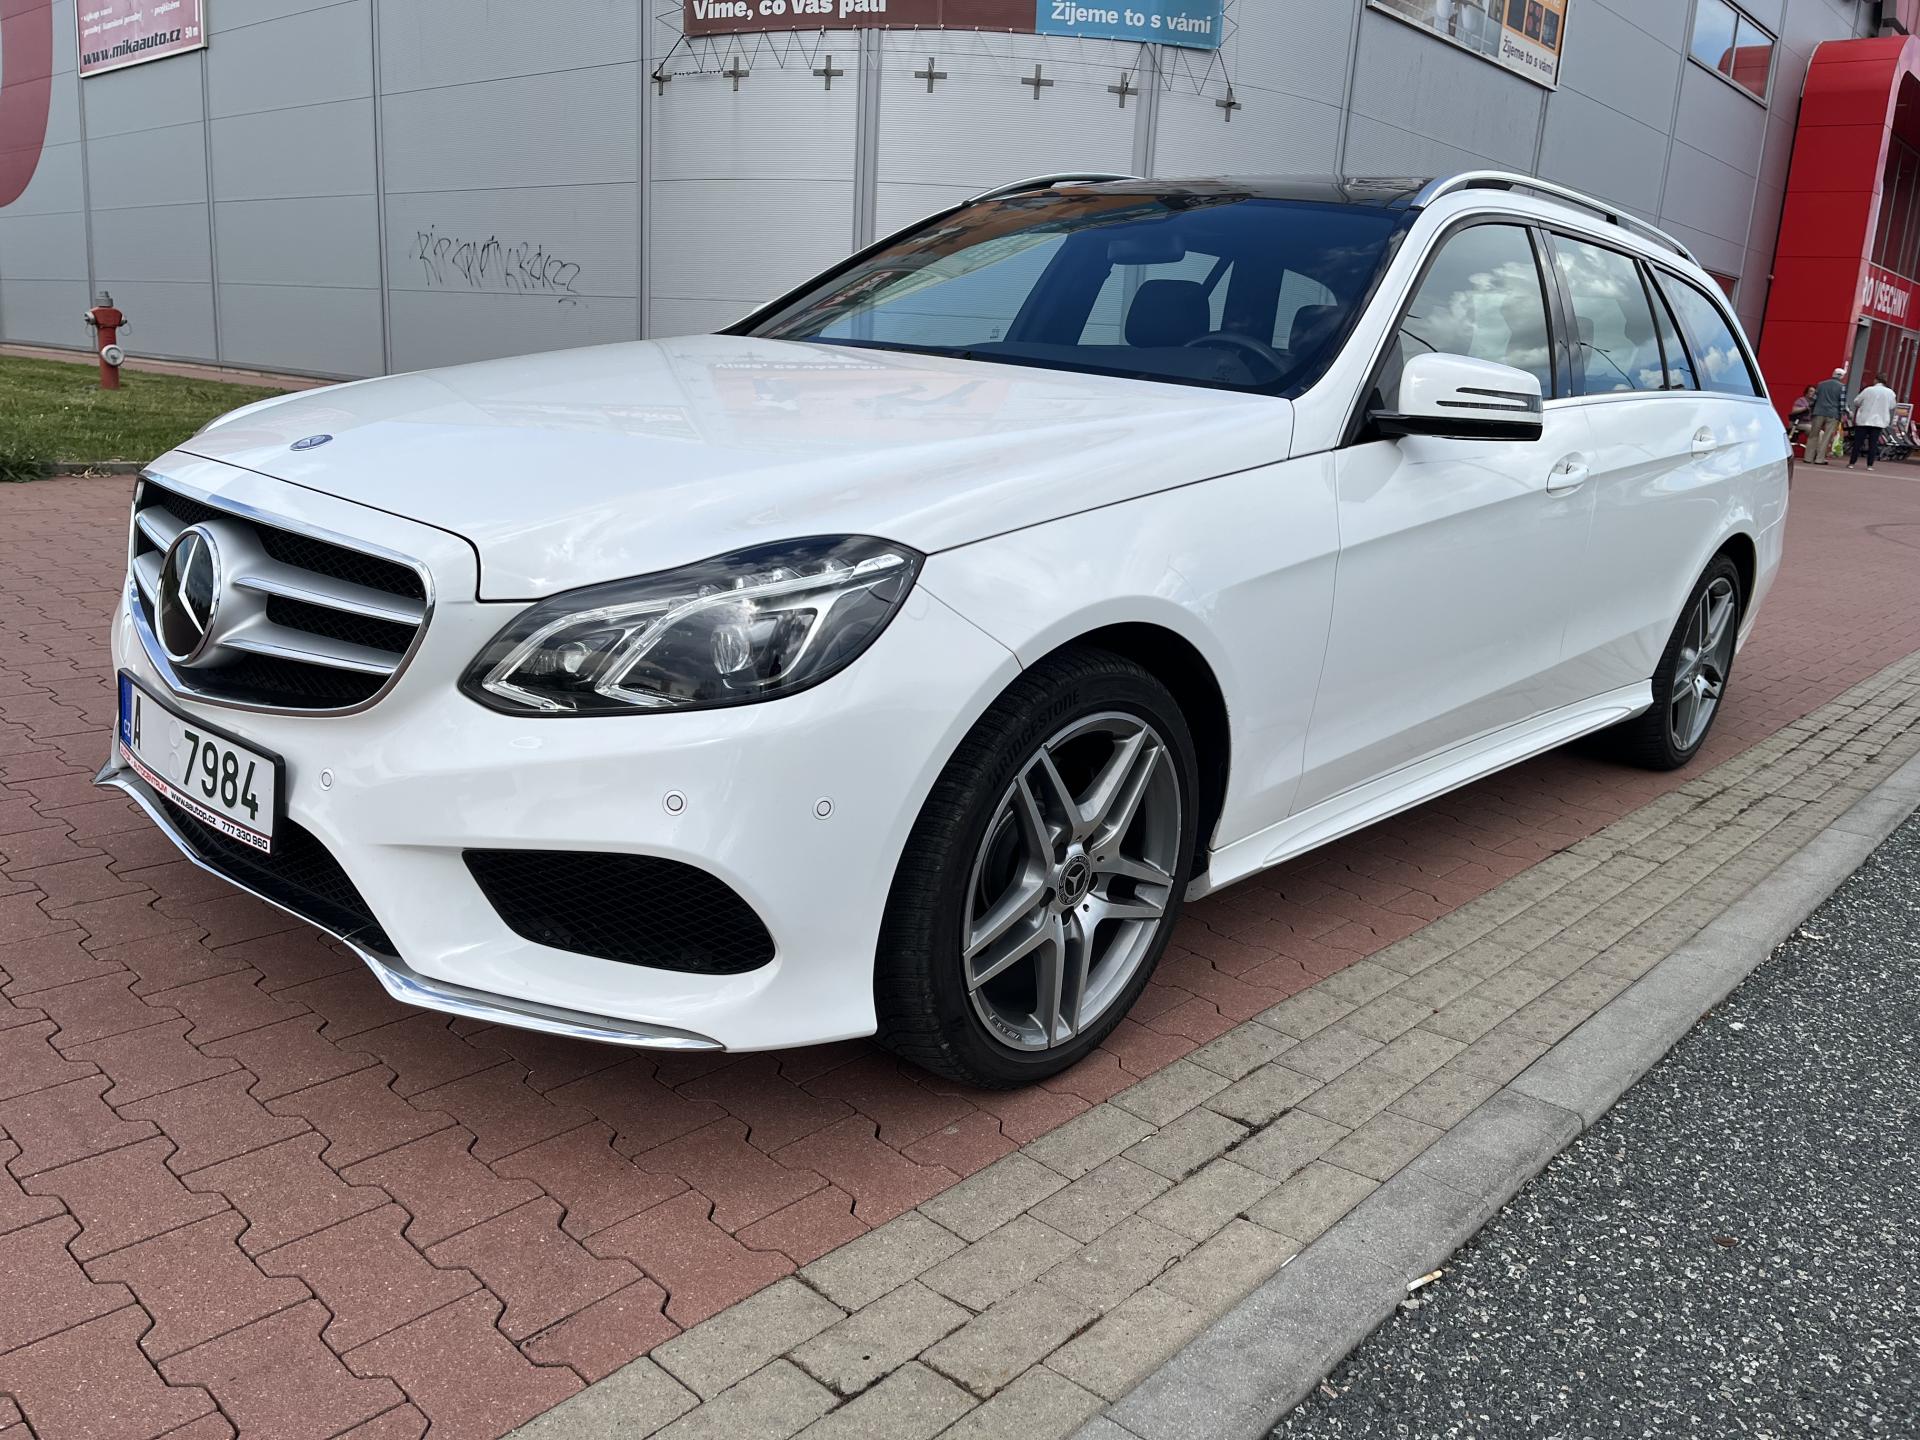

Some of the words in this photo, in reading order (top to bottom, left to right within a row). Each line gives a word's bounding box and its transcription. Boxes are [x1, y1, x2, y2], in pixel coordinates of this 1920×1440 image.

[759, 0, 787, 16] co
[1051, 0, 1119, 26] Žijeme
[1124, 8, 1145, 27] to
[1150, 14, 1161, 29] s
[1166, 12, 1211, 34] vámi
[83, 28, 181, 66] www.mikaauto.cz
[1525, 50, 1533, 65] to
[1534, 57, 1538, 68] s
[123, 719, 131, 737] CZ
[183, 729, 259, 821] 7984
[221, 821, 236, 835] 777
[236, 827, 252, 843] 330
[252, 835, 268, 850] 960
